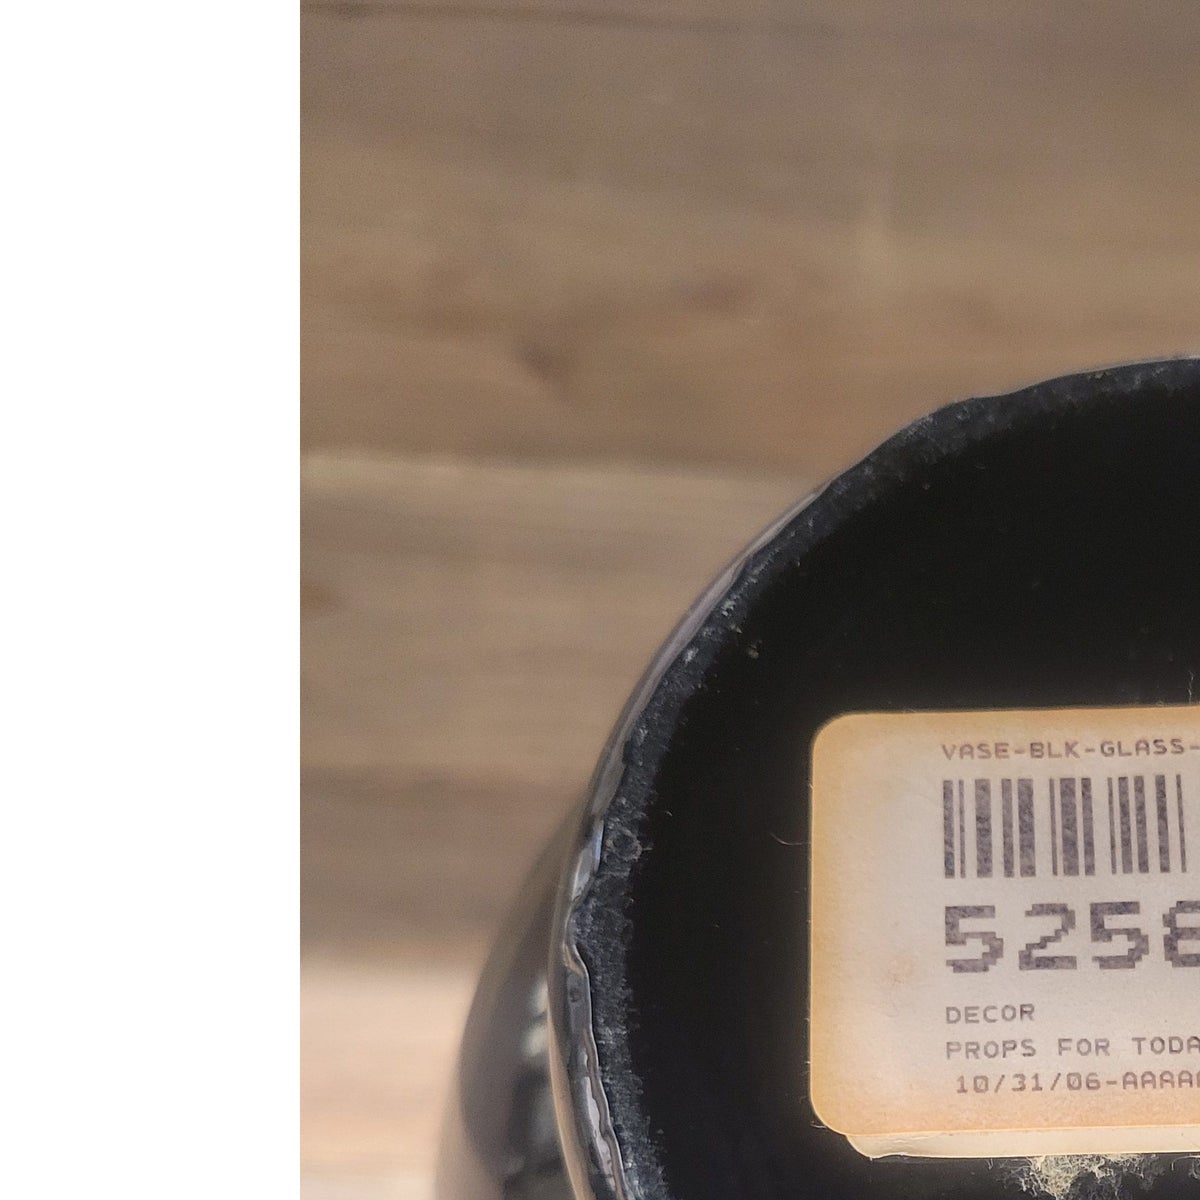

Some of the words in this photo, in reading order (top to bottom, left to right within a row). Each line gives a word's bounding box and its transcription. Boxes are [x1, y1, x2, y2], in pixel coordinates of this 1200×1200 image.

[946, 1003, 1035, 1024] DECOR
[946, 1038, 1036, 1060] PROPS
[1058, 1037, 1109, 1056] FOR
